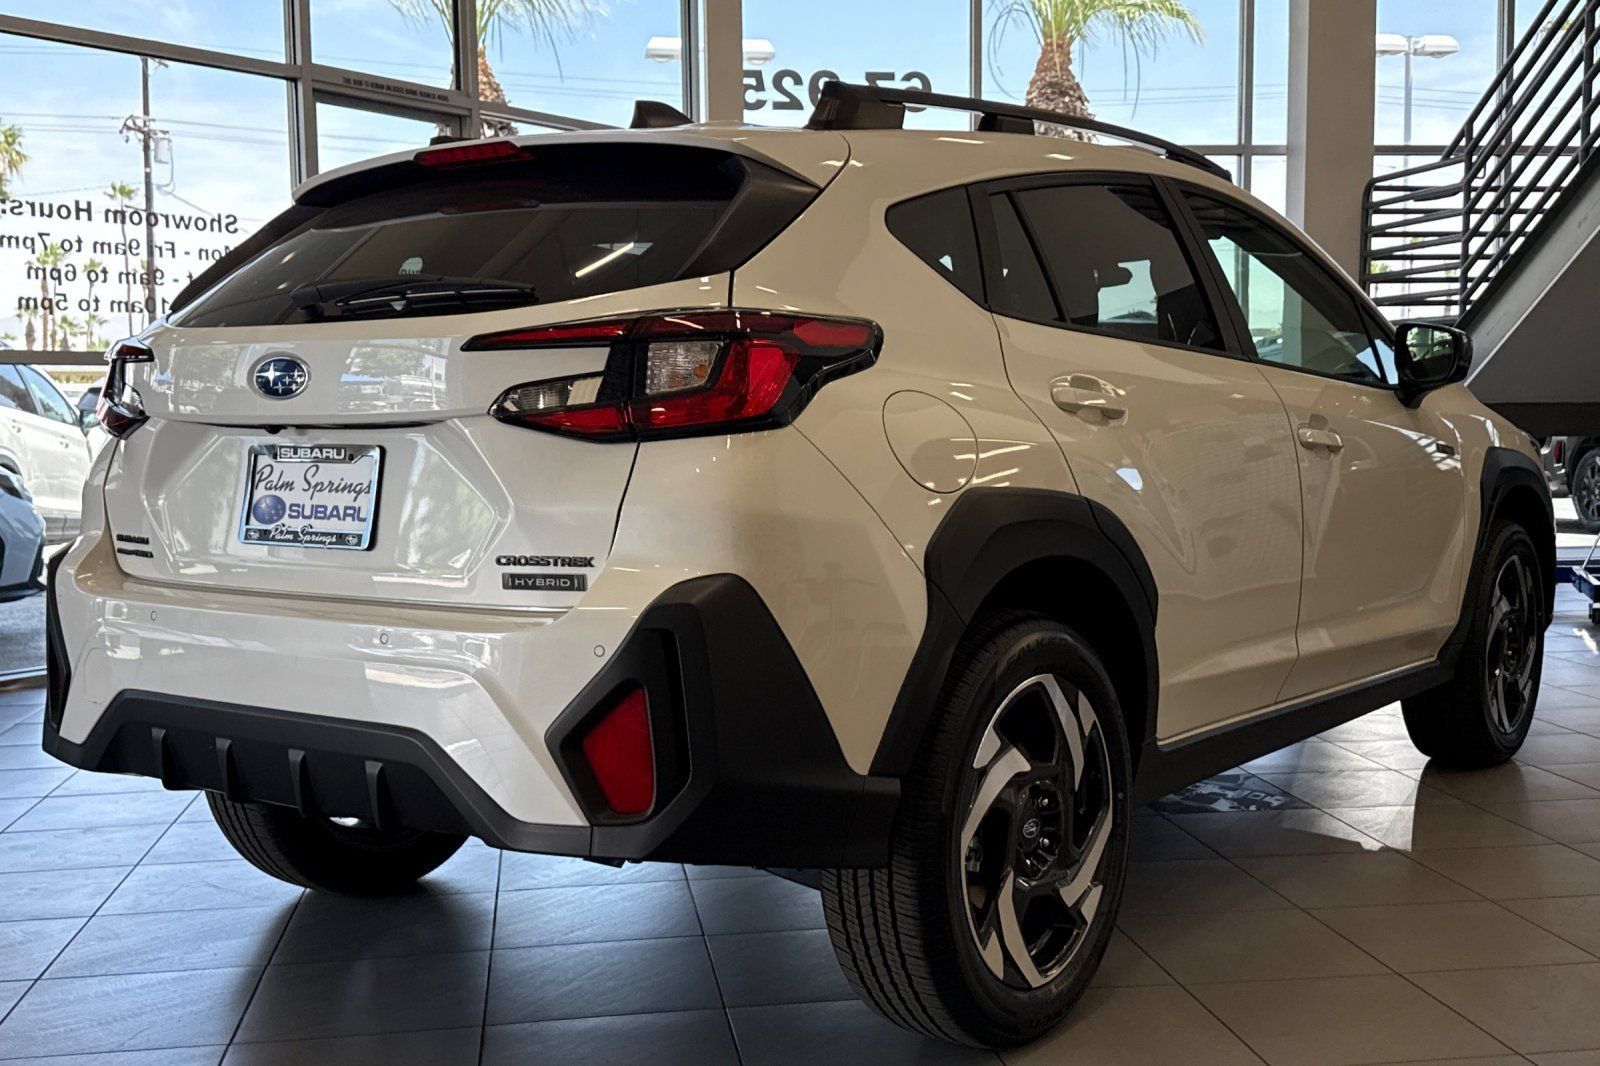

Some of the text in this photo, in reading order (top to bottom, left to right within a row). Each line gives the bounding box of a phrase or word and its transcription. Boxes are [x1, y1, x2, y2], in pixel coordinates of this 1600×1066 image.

[280, 447, 345, 460] SUBARU
[254, 463, 372, 502] Palm Springs
[269, 523, 337, 546] Palm Springs
[495, 555, 596, 568] CROSSTREK
[514, 577, 571, 587] HYBRID
